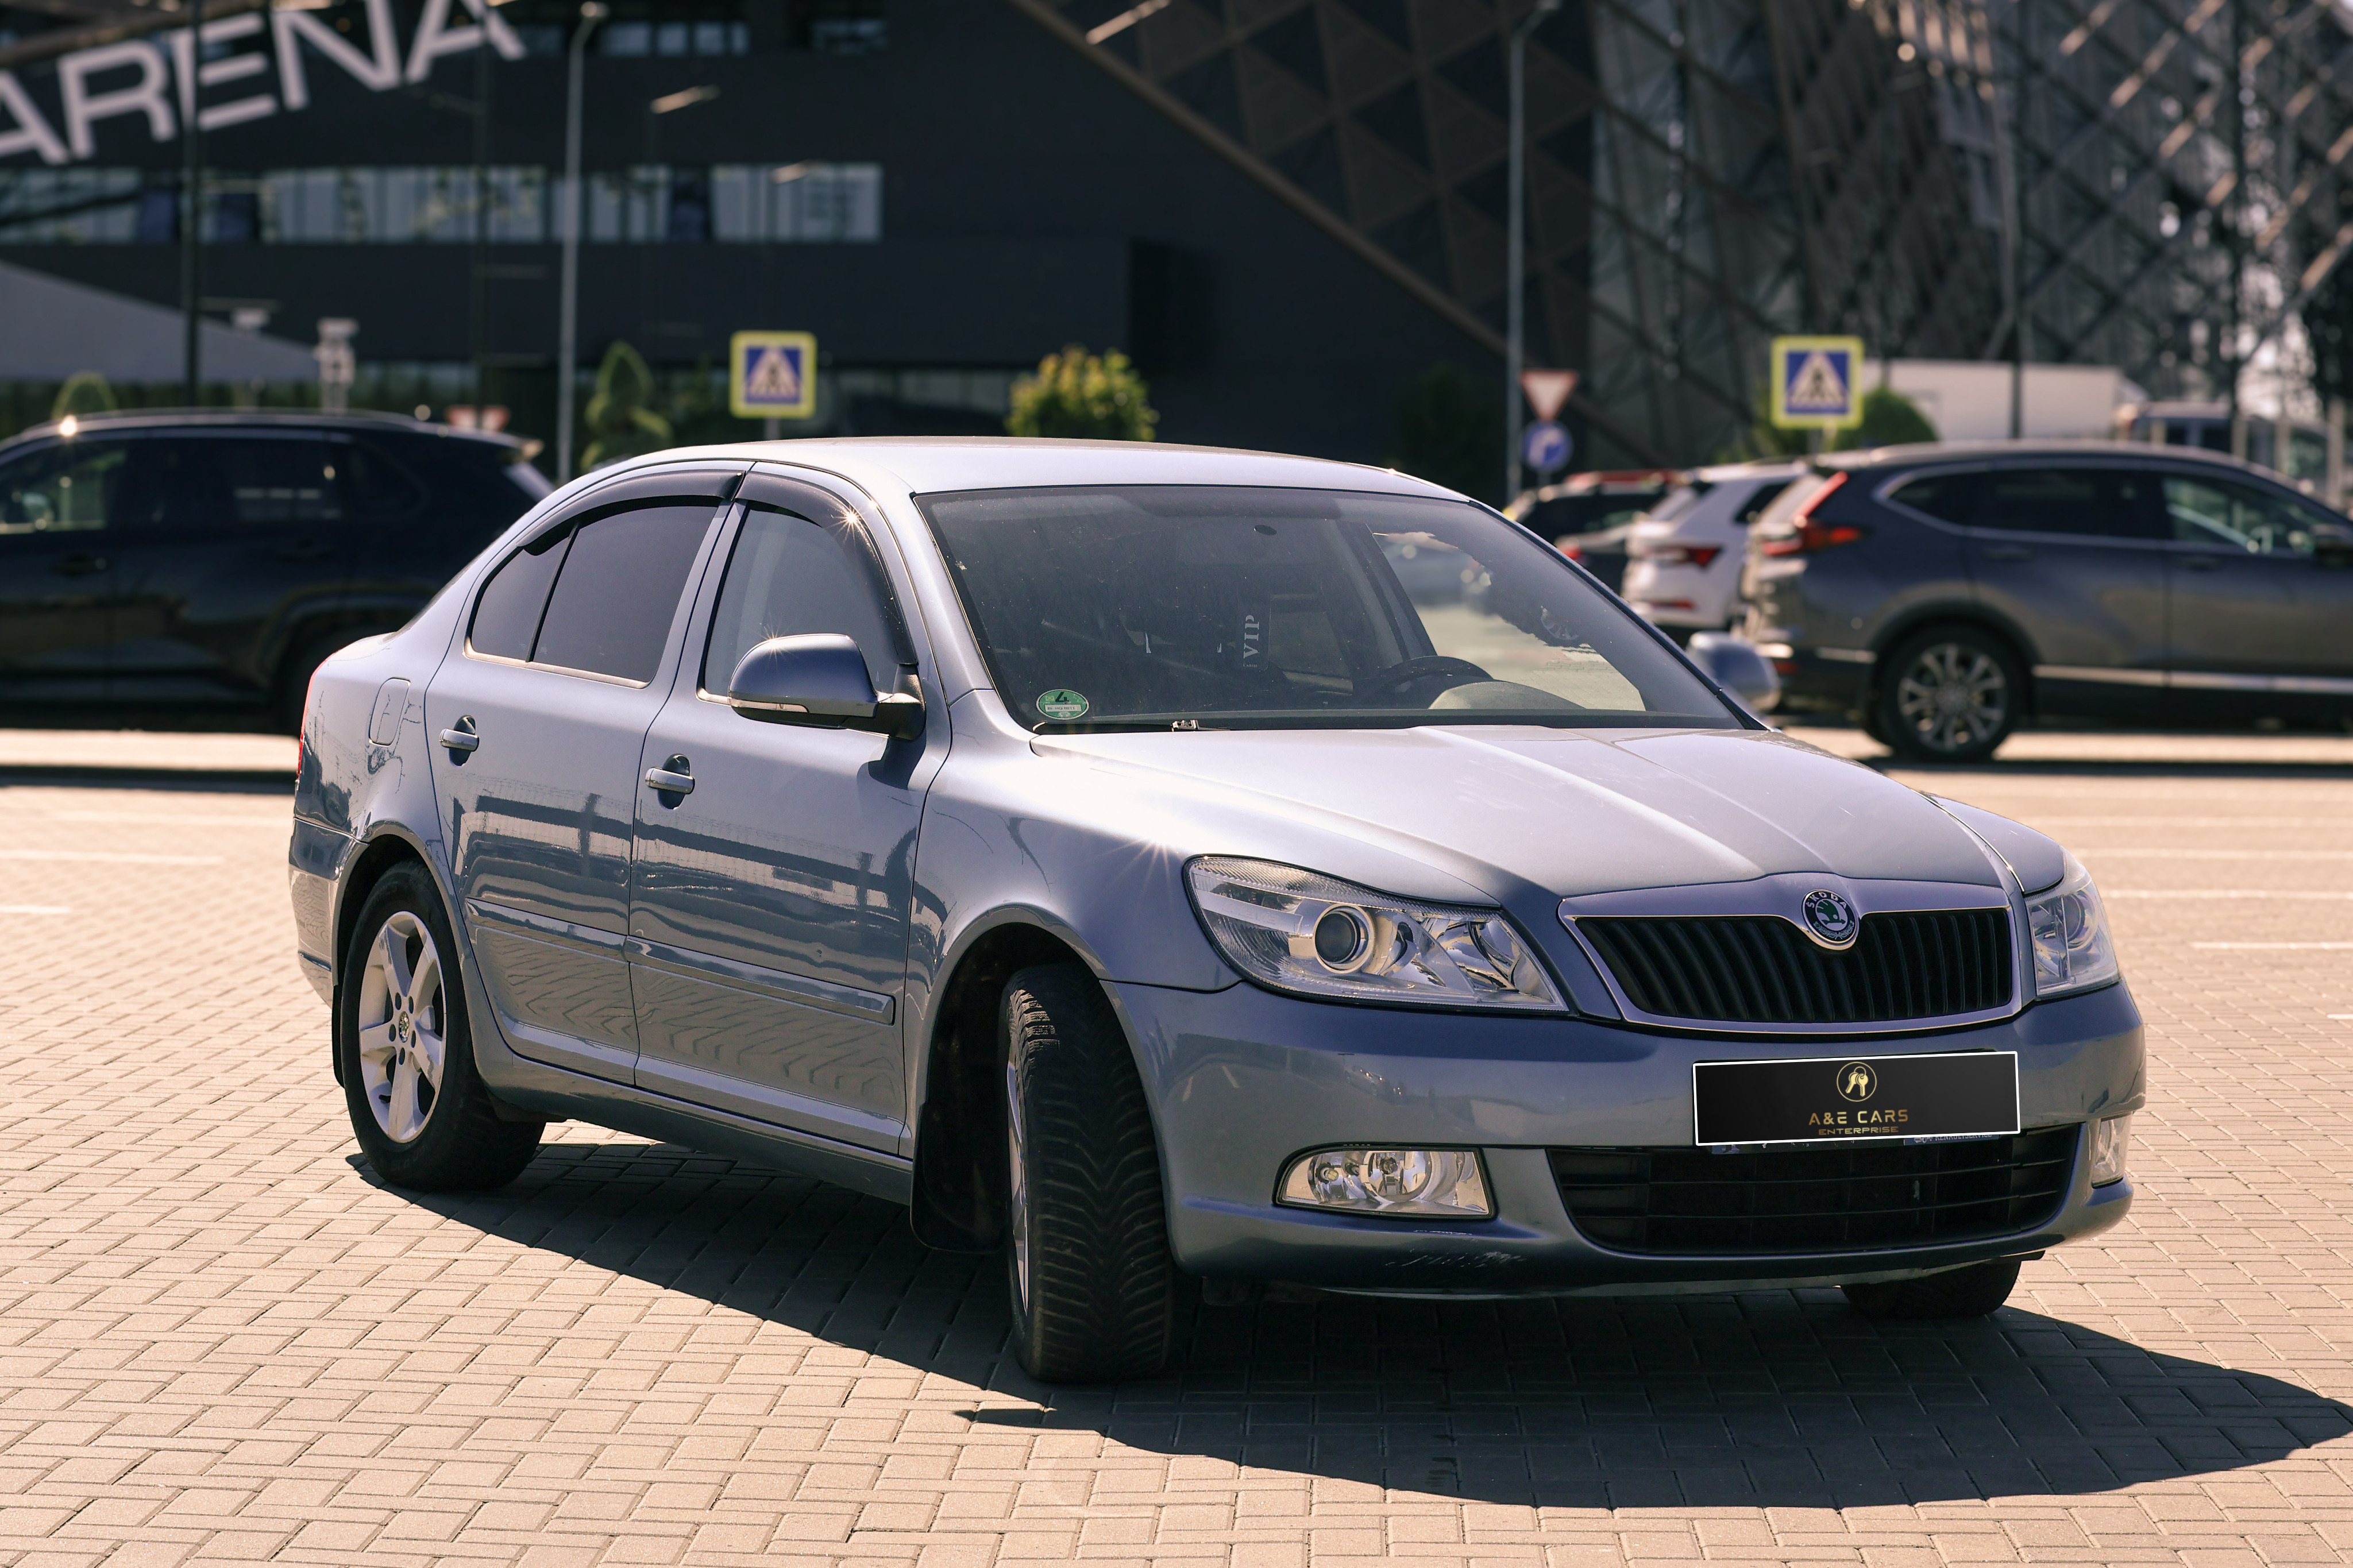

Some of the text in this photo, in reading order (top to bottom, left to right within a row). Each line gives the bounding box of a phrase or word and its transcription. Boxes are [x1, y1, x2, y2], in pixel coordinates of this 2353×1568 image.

[0, 0, 525, 164] ARENA
[1243, 615, 1259, 659] VIP
[1055, 692, 1069, 702] 4
